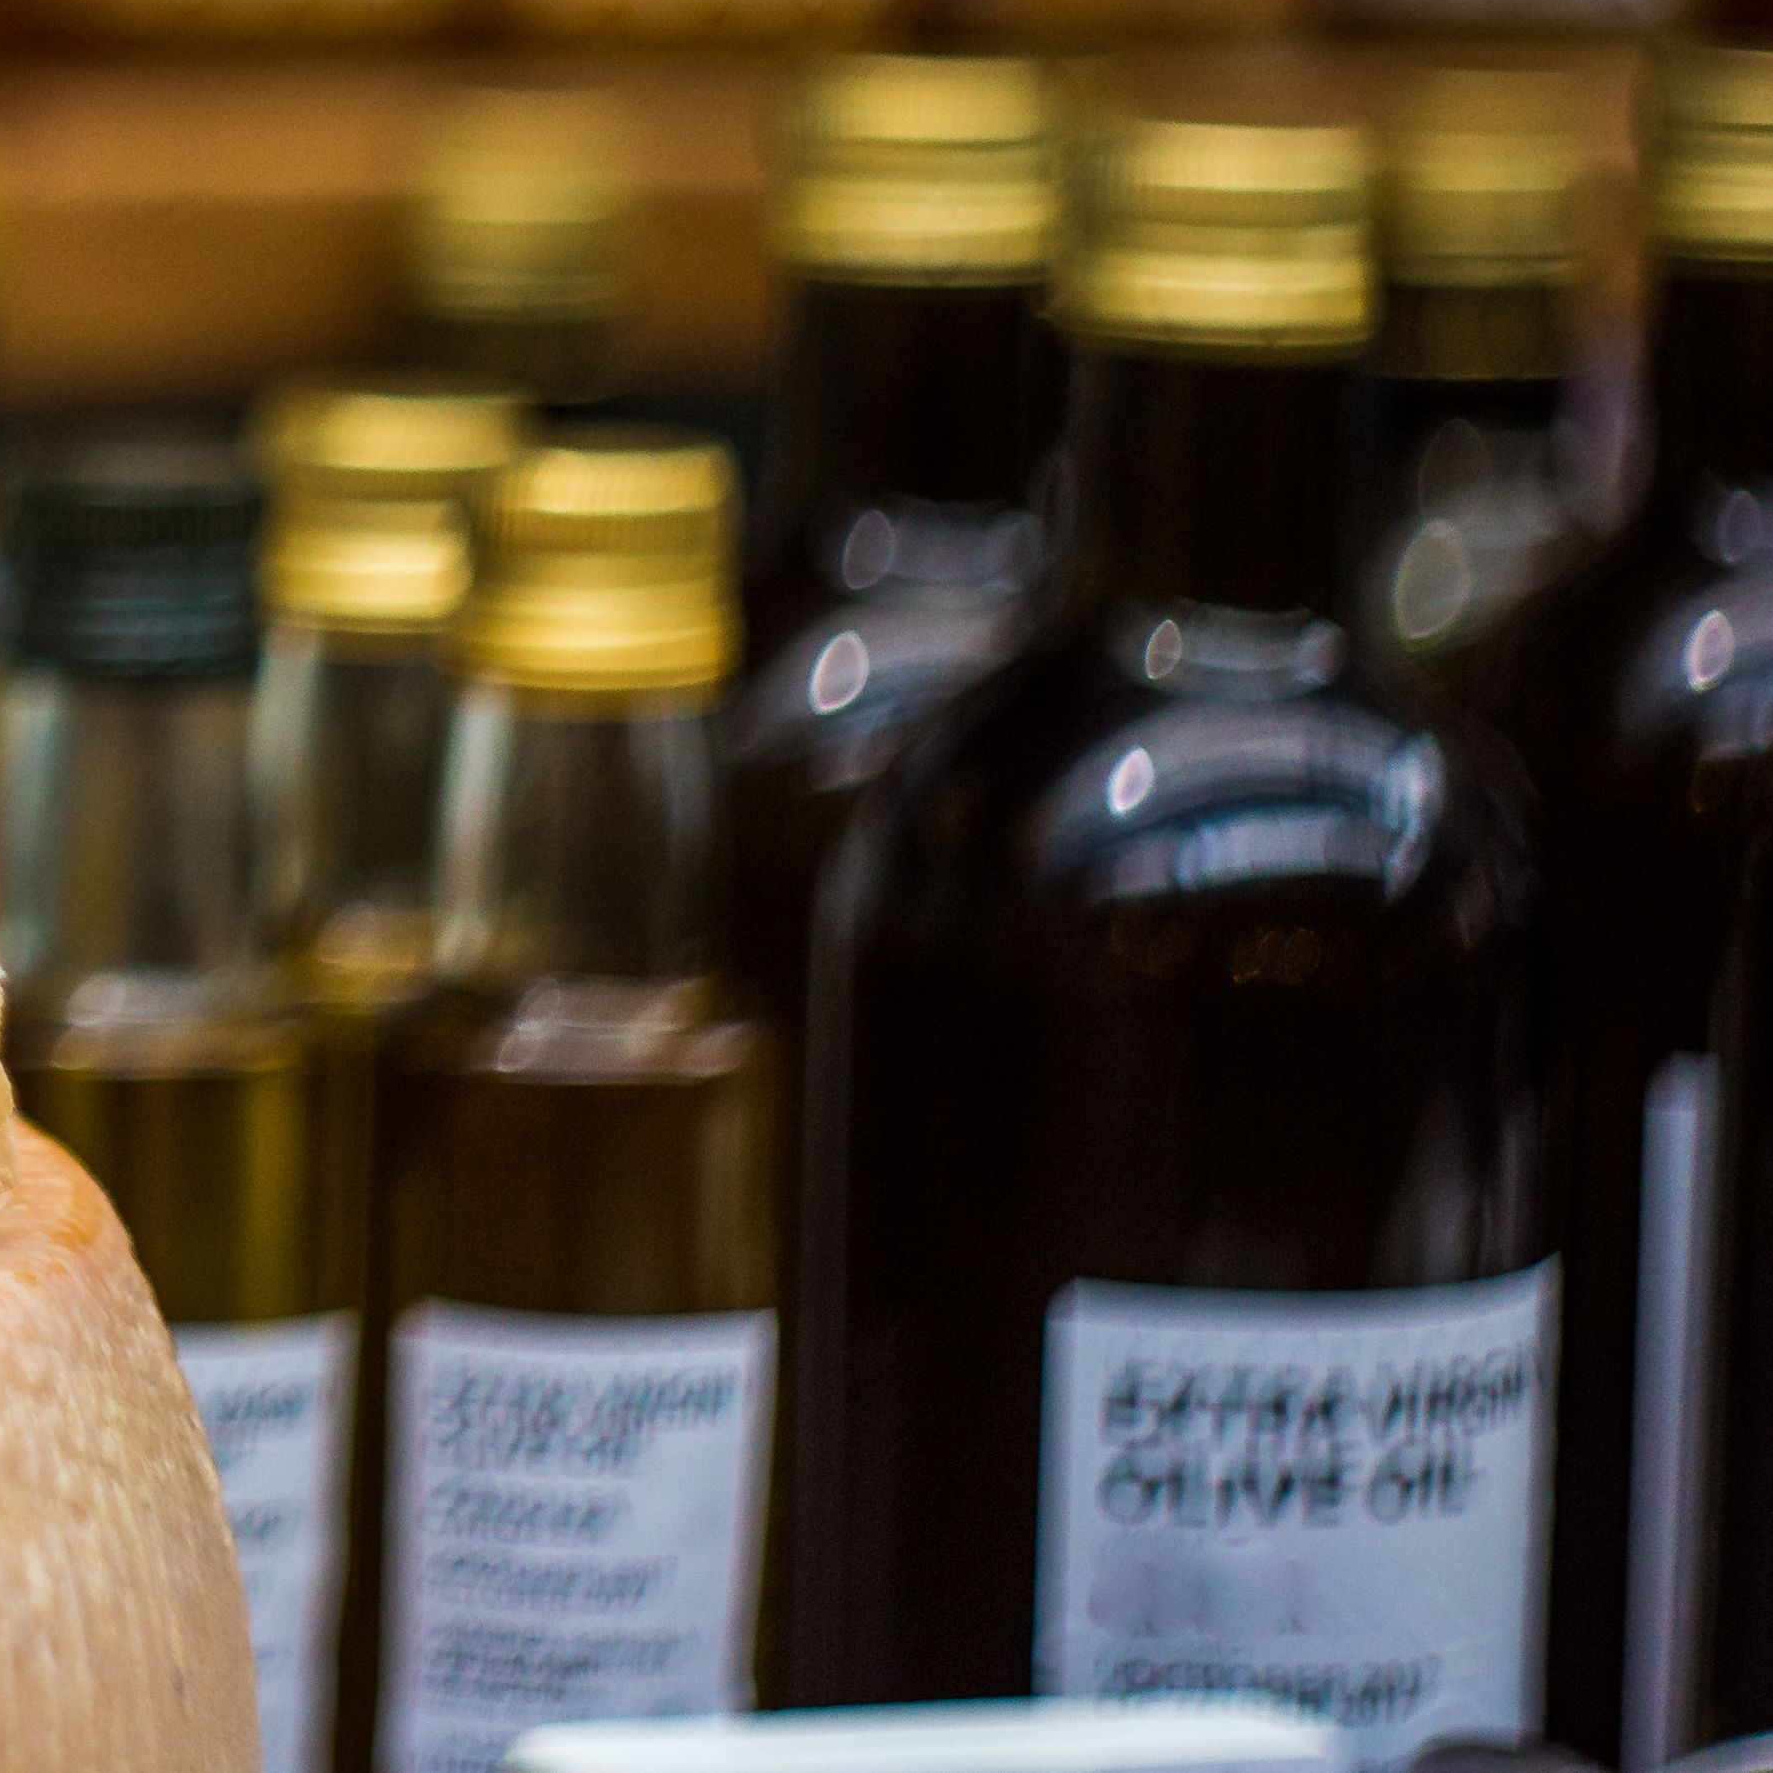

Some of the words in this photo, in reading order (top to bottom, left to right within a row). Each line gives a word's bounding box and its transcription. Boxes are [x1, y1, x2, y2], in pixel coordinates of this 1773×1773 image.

[1098, 1357, 1354, 1443] EXTRA
[1094, 1443, 1346, 1529] OLIVE
[1360, 1445, 1478, 1523] OIL
